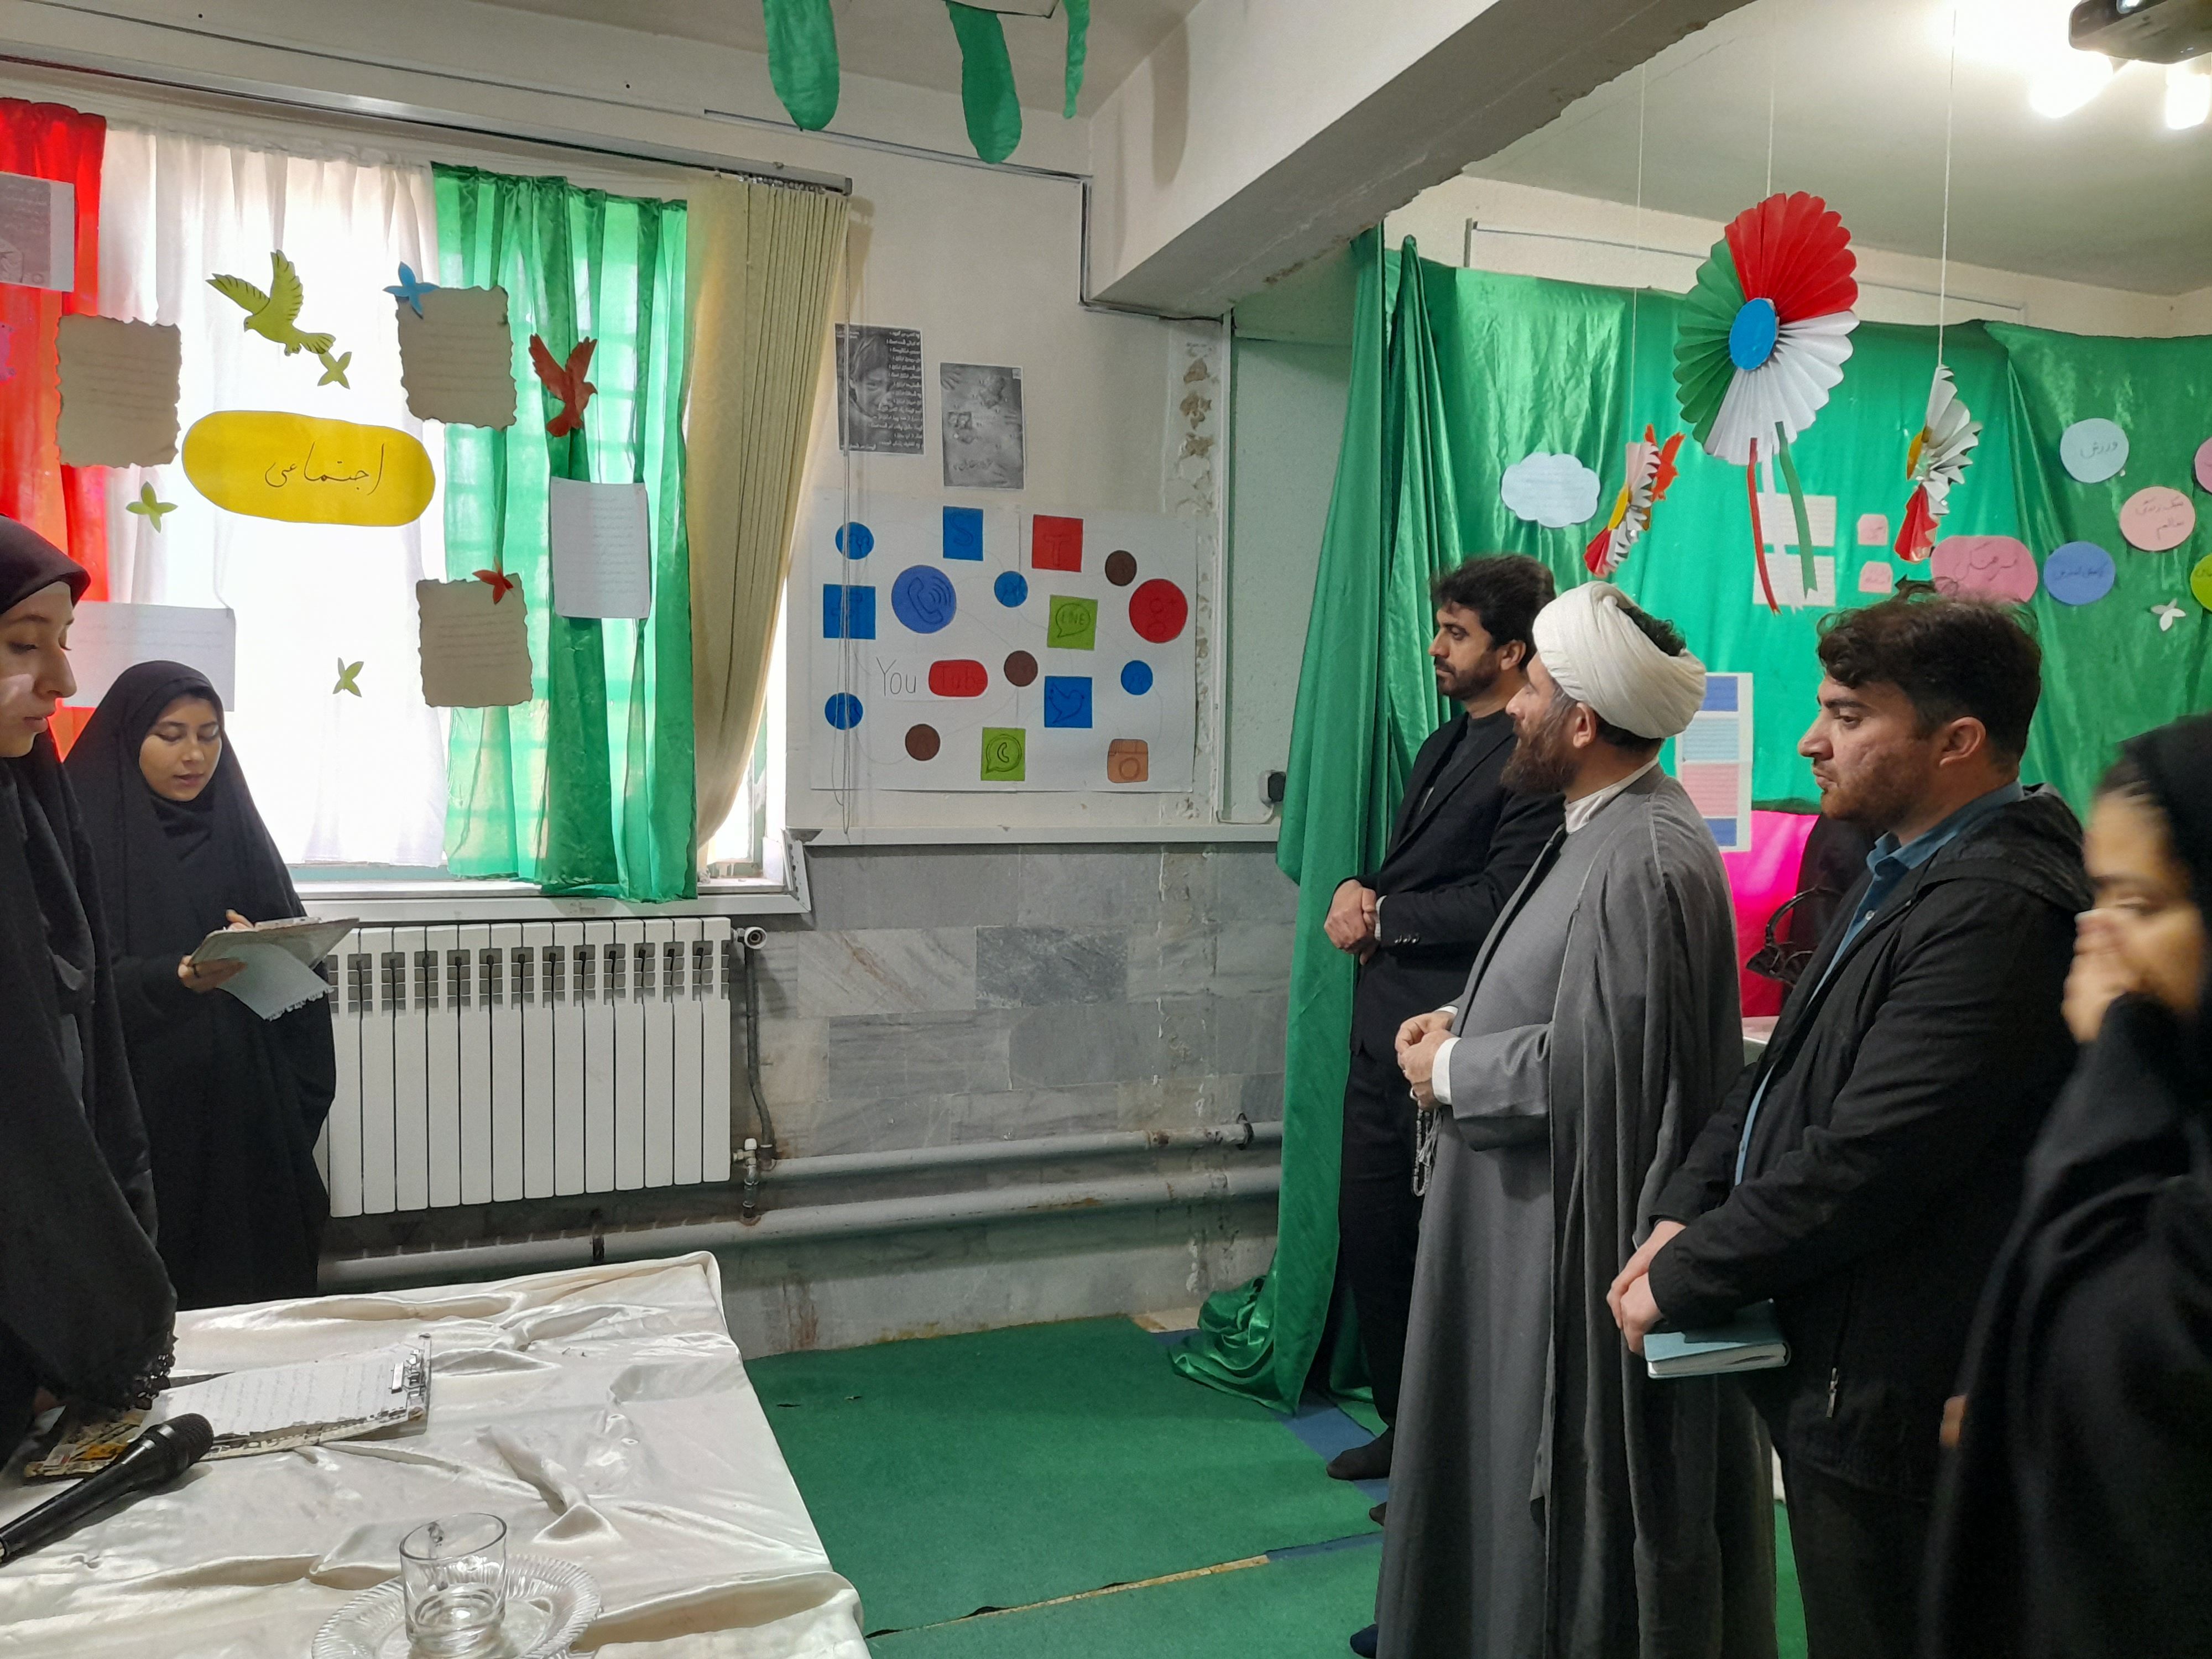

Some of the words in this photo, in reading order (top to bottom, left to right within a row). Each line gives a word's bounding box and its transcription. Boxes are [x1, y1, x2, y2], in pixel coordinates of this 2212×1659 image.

[2080, 441, 2118, 460] ورزش
[265, 441, 385, 495] اجتماعی
[2156, 517, 2184, 540] سالم
[875, 656, 916, 697] You
[938, 665, 985, 690] Tube
